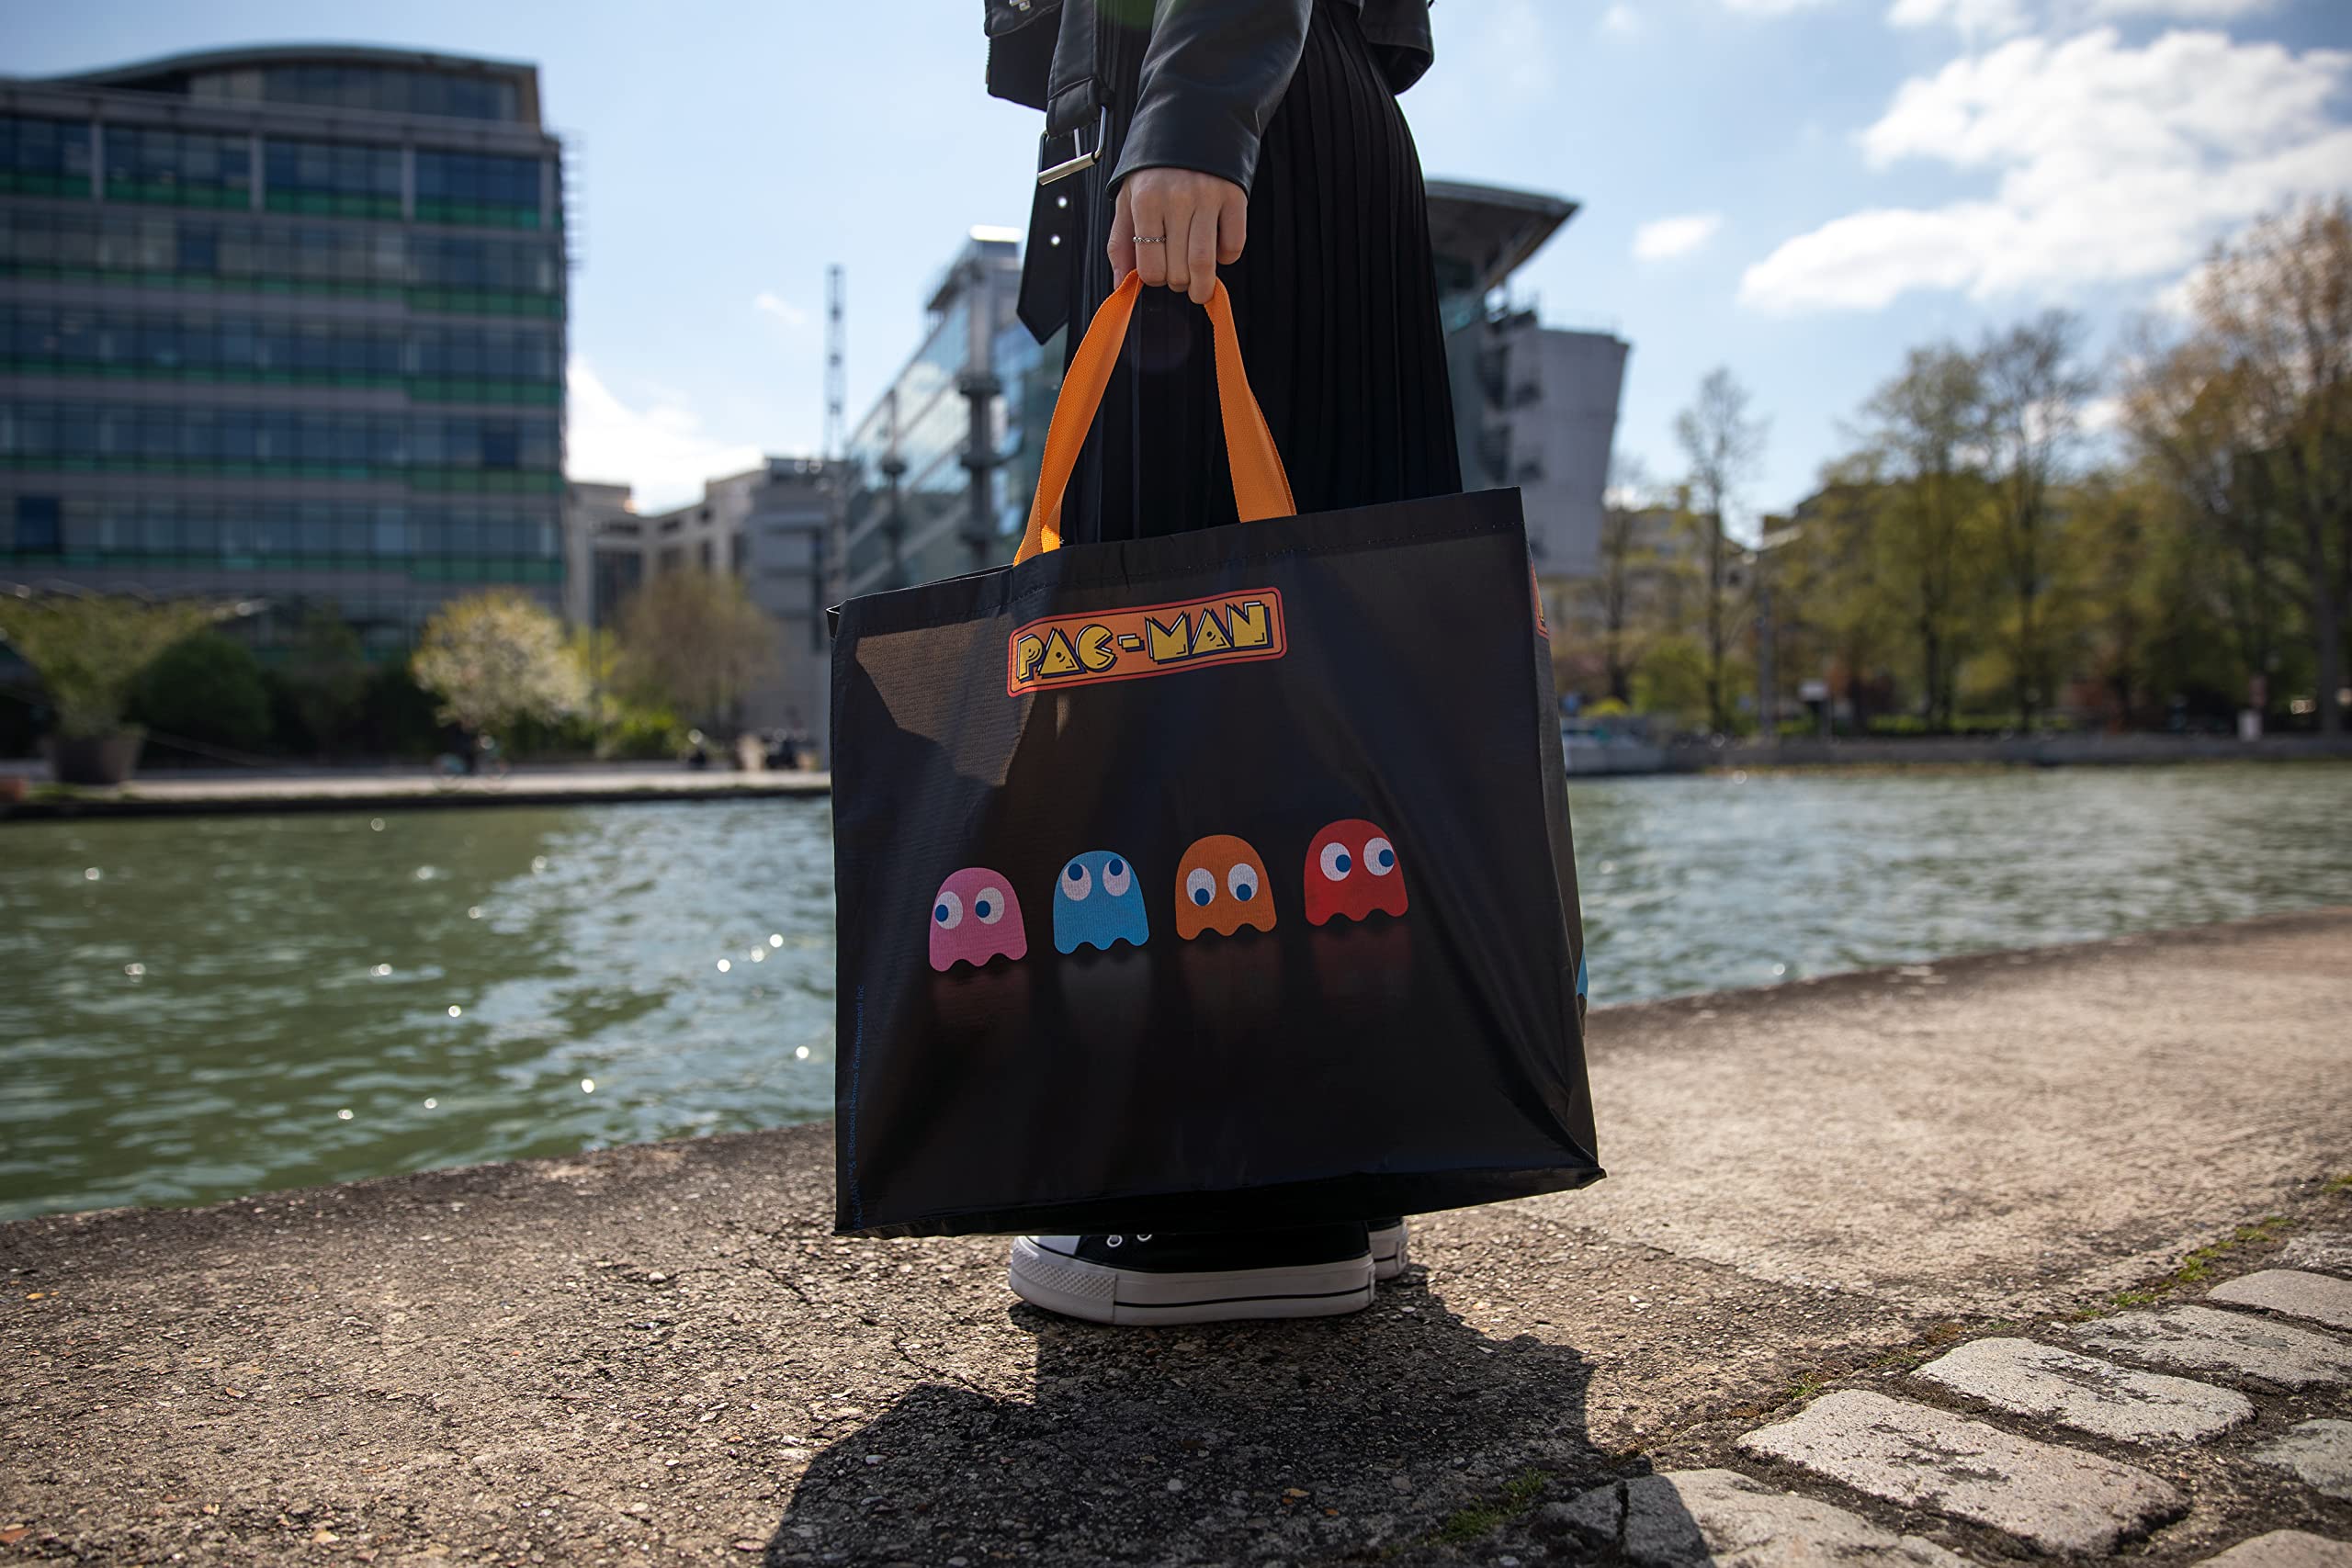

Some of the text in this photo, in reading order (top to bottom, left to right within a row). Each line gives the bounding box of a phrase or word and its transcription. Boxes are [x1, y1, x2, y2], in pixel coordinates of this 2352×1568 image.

[1016, 601, 1274, 682] PAC-MAN
[853, 1002, 864, 1070] Entertainment
[849, 1072, 860, 1109] Namco
